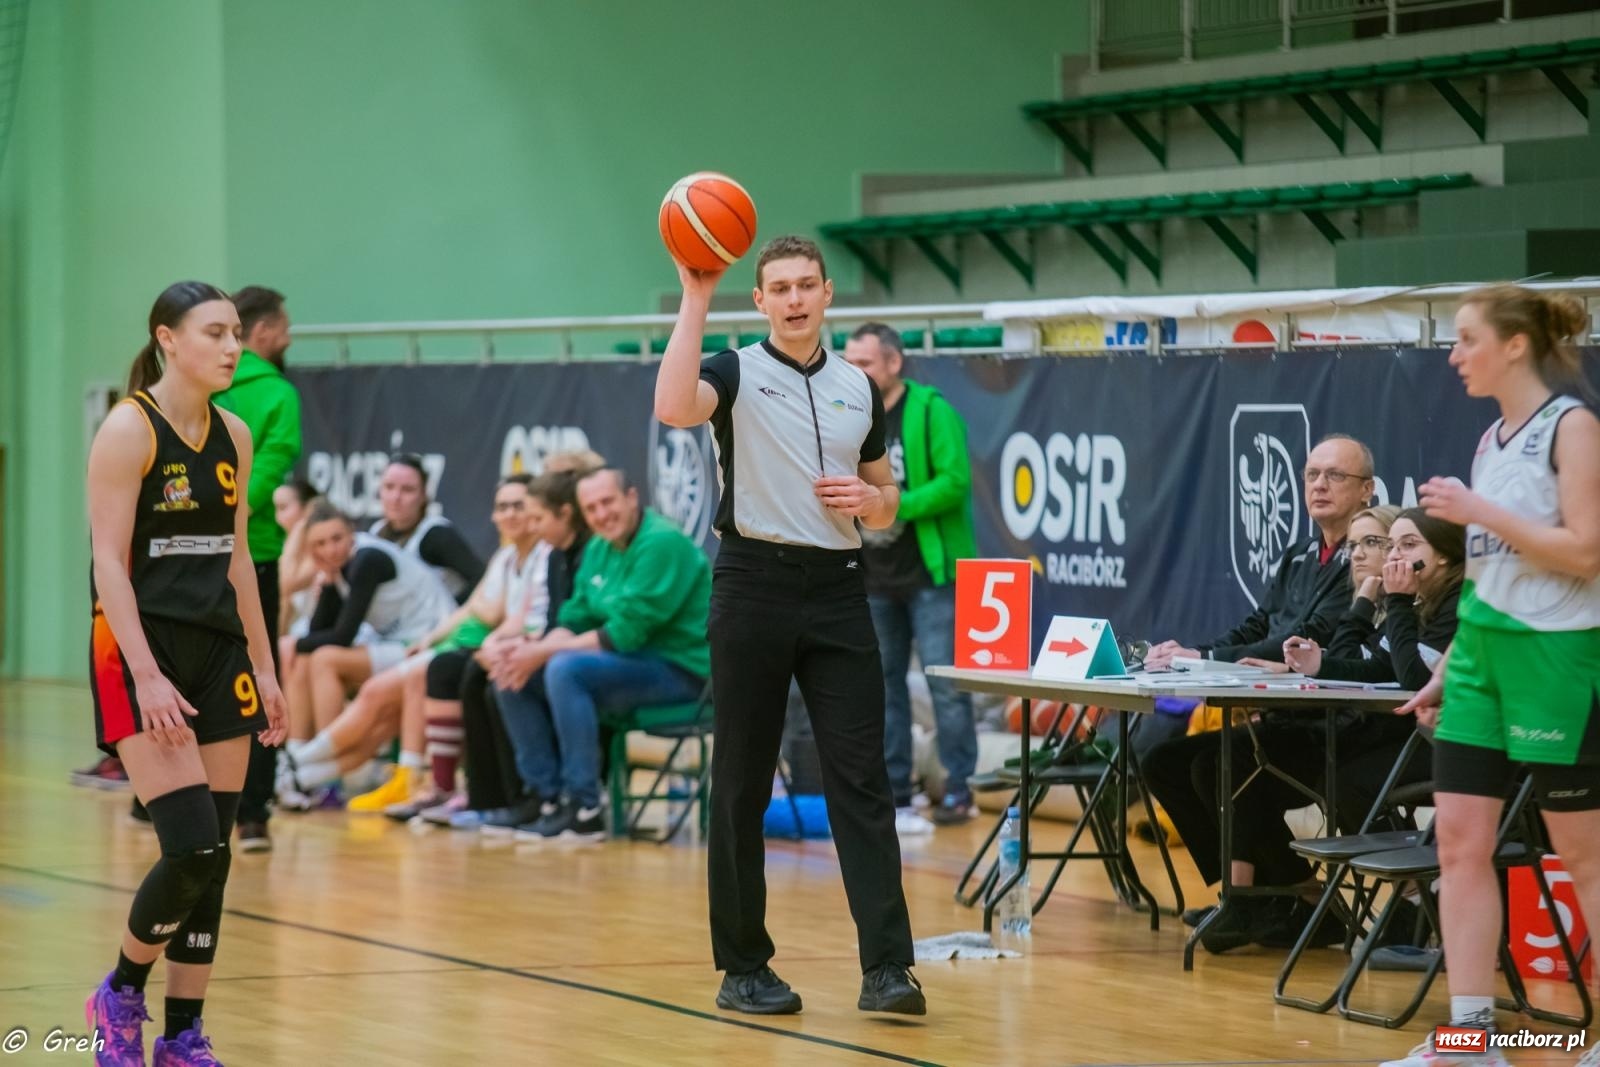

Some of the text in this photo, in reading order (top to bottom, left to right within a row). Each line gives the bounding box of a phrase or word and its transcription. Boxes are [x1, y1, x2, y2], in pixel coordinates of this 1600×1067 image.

[215, 462, 239, 506] 9
[1046, 546, 1128, 588] RACIBÓRZ
[967, 571, 1015, 644] 5
[234, 671, 259, 717] 9
[1524, 870, 1575, 948] 5
